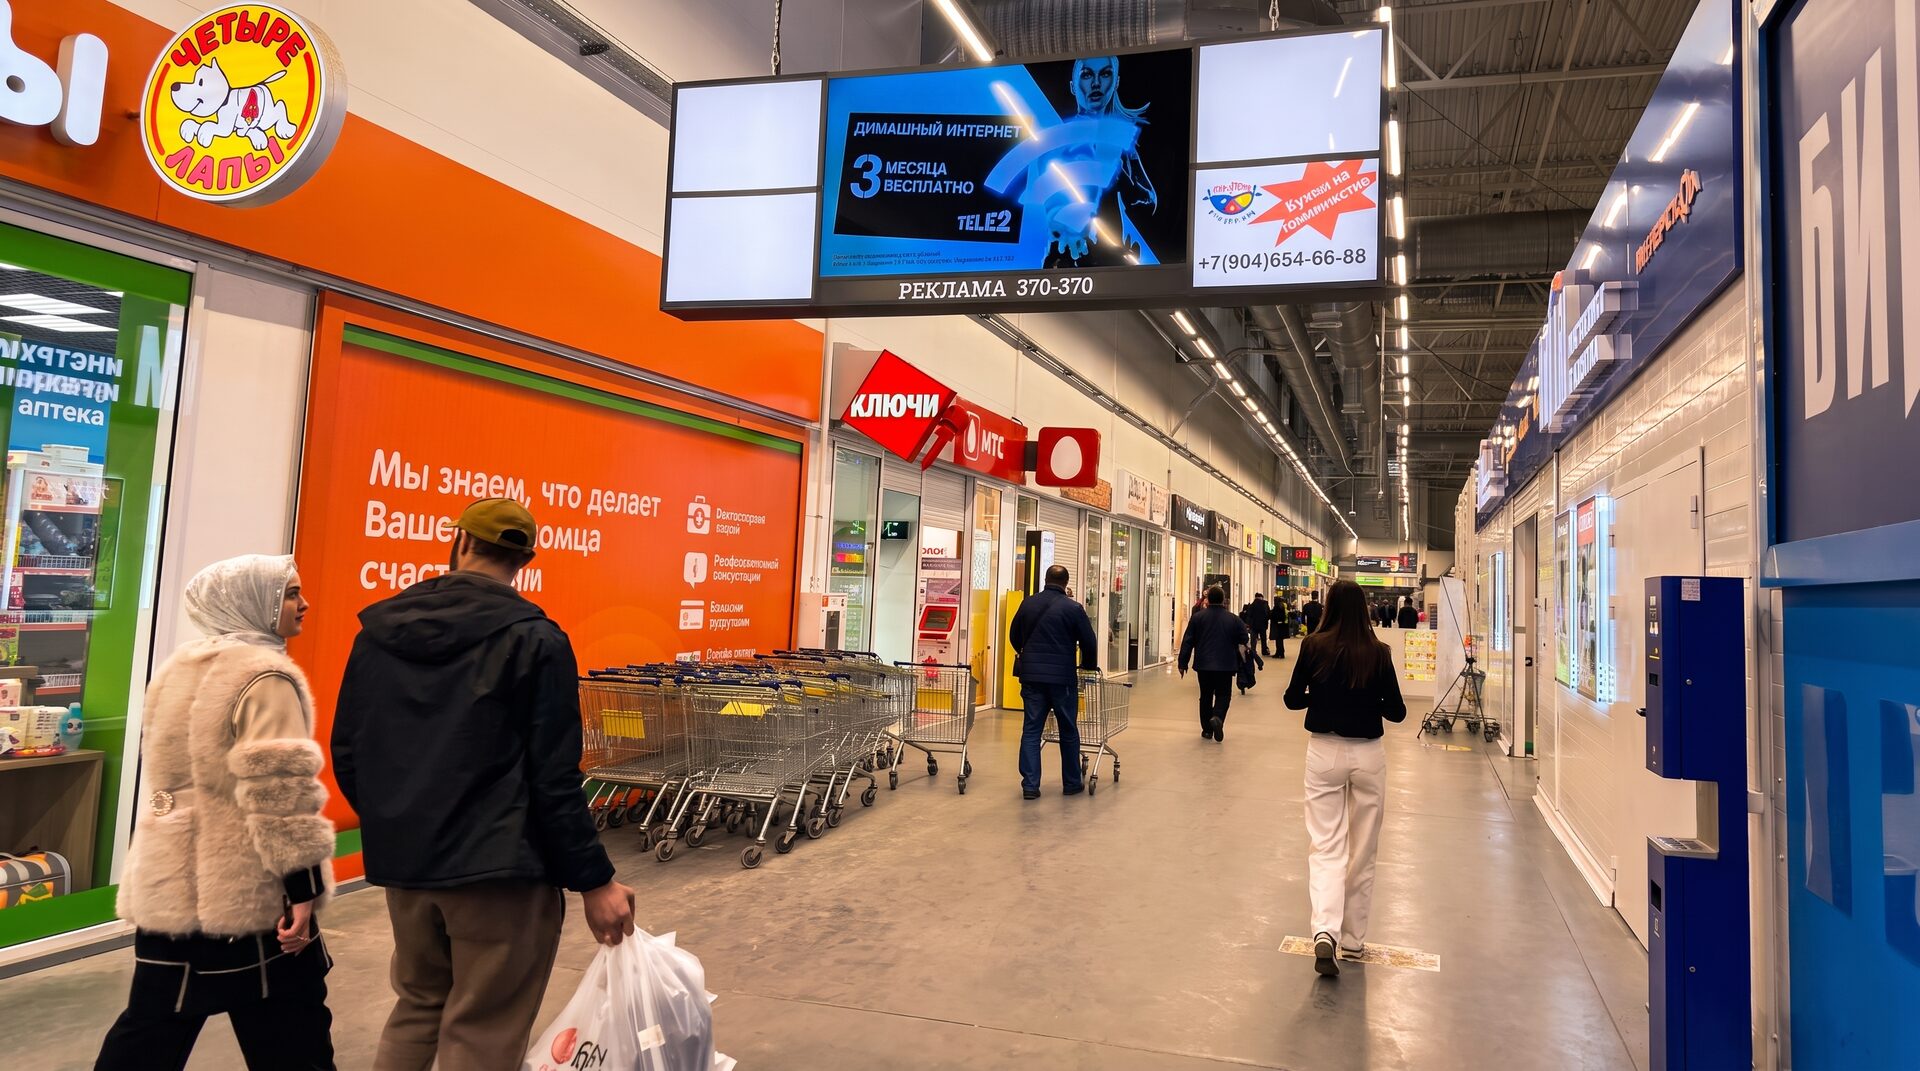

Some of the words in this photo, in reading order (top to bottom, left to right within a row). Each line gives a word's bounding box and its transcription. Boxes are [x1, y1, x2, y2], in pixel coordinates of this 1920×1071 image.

[171, 10, 306, 67] ЧЕТЫРЕ
[946, 124, 1022, 138] ИНТЕРНЕТ
[165, 136, 284, 190] ЛАПЫ
[850, 154, 882, 199] 3
[886, 161, 947, 177] МЕСЯЦА
[957, 210, 1011, 232] TELE2
[1199, 249, 1367, 273] +7(904)654-66-88
[898, 280, 1006, 300] РЕКЛАМА
[1016, 277, 1094, 296] 370-370
[18, 398, 105, 426] аптека
[850, 393, 939, 417] КЛЮЧИ
[981, 428, 1005, 460] МТС
[369, 448, 429, 491] Мы
[438, 466, 532, 509] знаем,
[541, 481, 582, 509] что
[587, 488, 661, 518] делает
